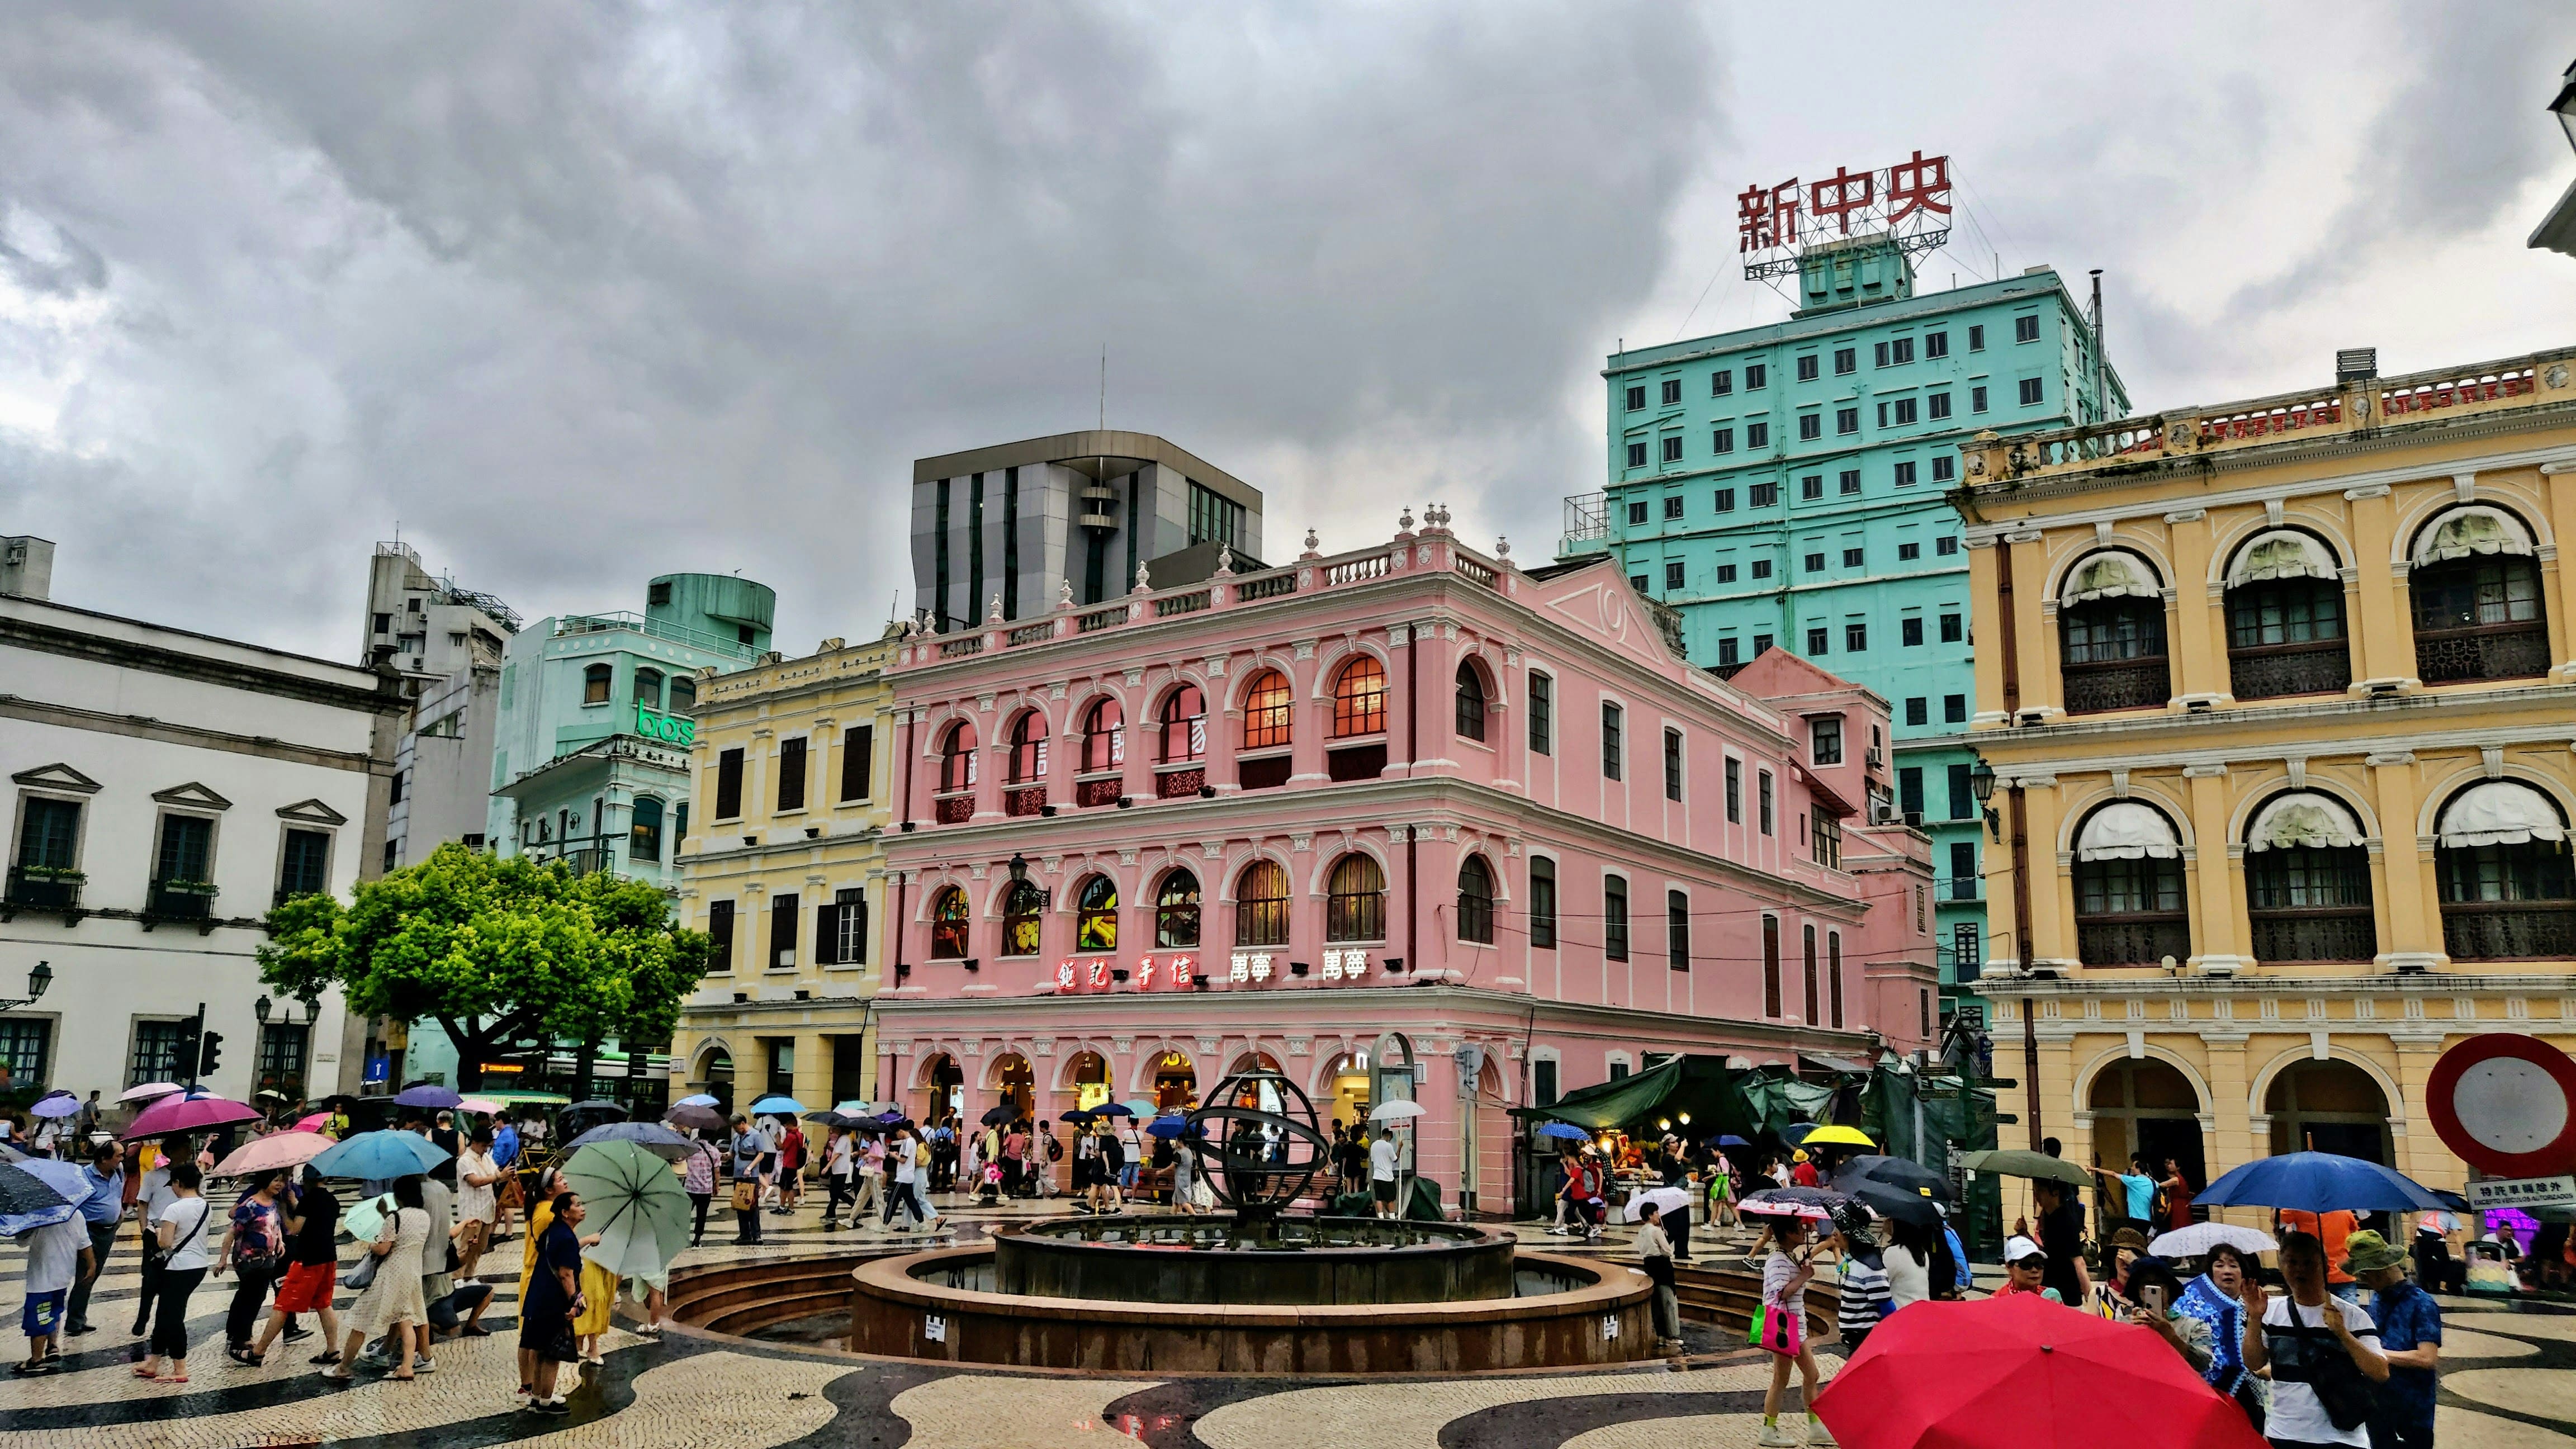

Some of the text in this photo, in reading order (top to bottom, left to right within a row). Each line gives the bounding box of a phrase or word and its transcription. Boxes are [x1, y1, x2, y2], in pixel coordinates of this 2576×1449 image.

[1738, 150, 1953, 253] 新中央
[1055, 953, 1194, 991] 鉅記手信
[1230, 953, 1271, 983] 萬寧
[1322, 949, 1367, 980] 萬寧
[2531, 1193, 2574, 1202] AUTORIZADOS
